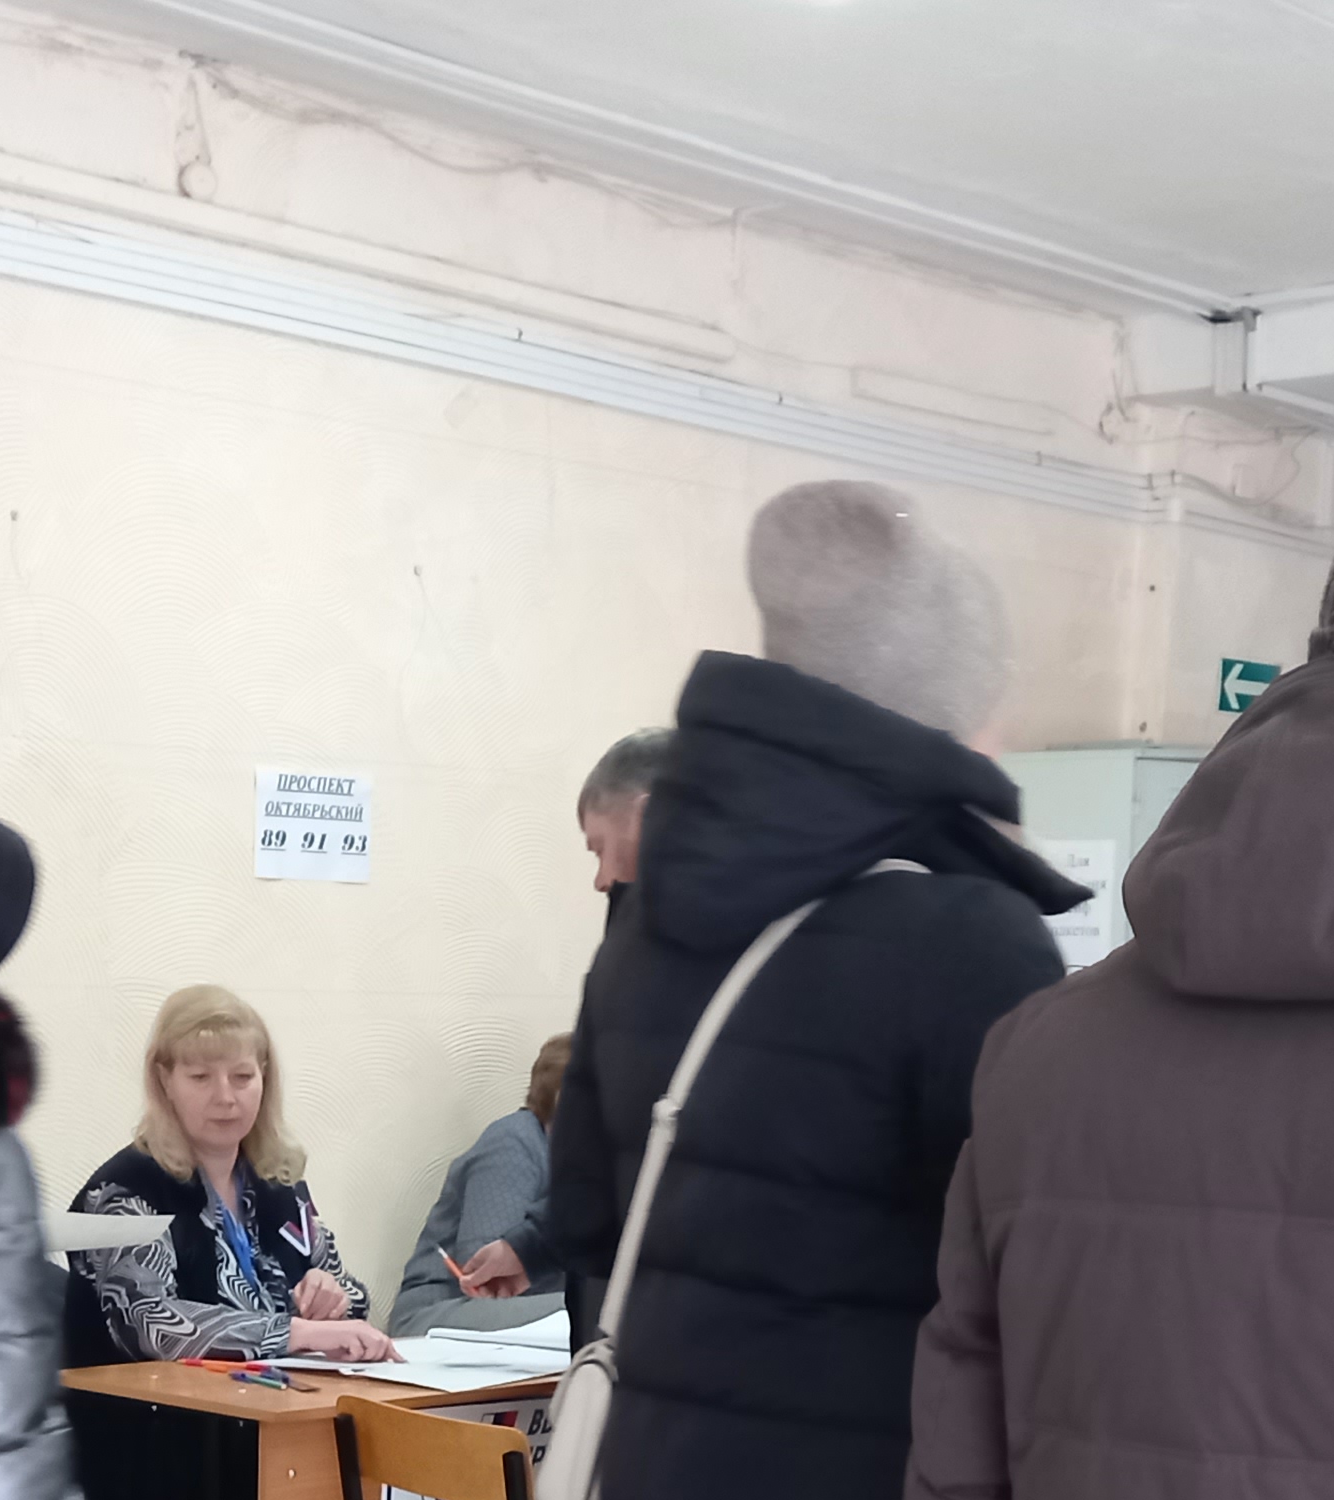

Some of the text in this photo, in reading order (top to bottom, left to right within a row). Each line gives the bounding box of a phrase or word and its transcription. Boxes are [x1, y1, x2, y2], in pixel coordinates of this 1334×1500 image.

[276, 773, 356, 797] ПРОСПЕКТ
[264, 800, 364, 822] ОКТЯБРЬСКИЙ
[260, 828, 368, 853] 89 91 93
